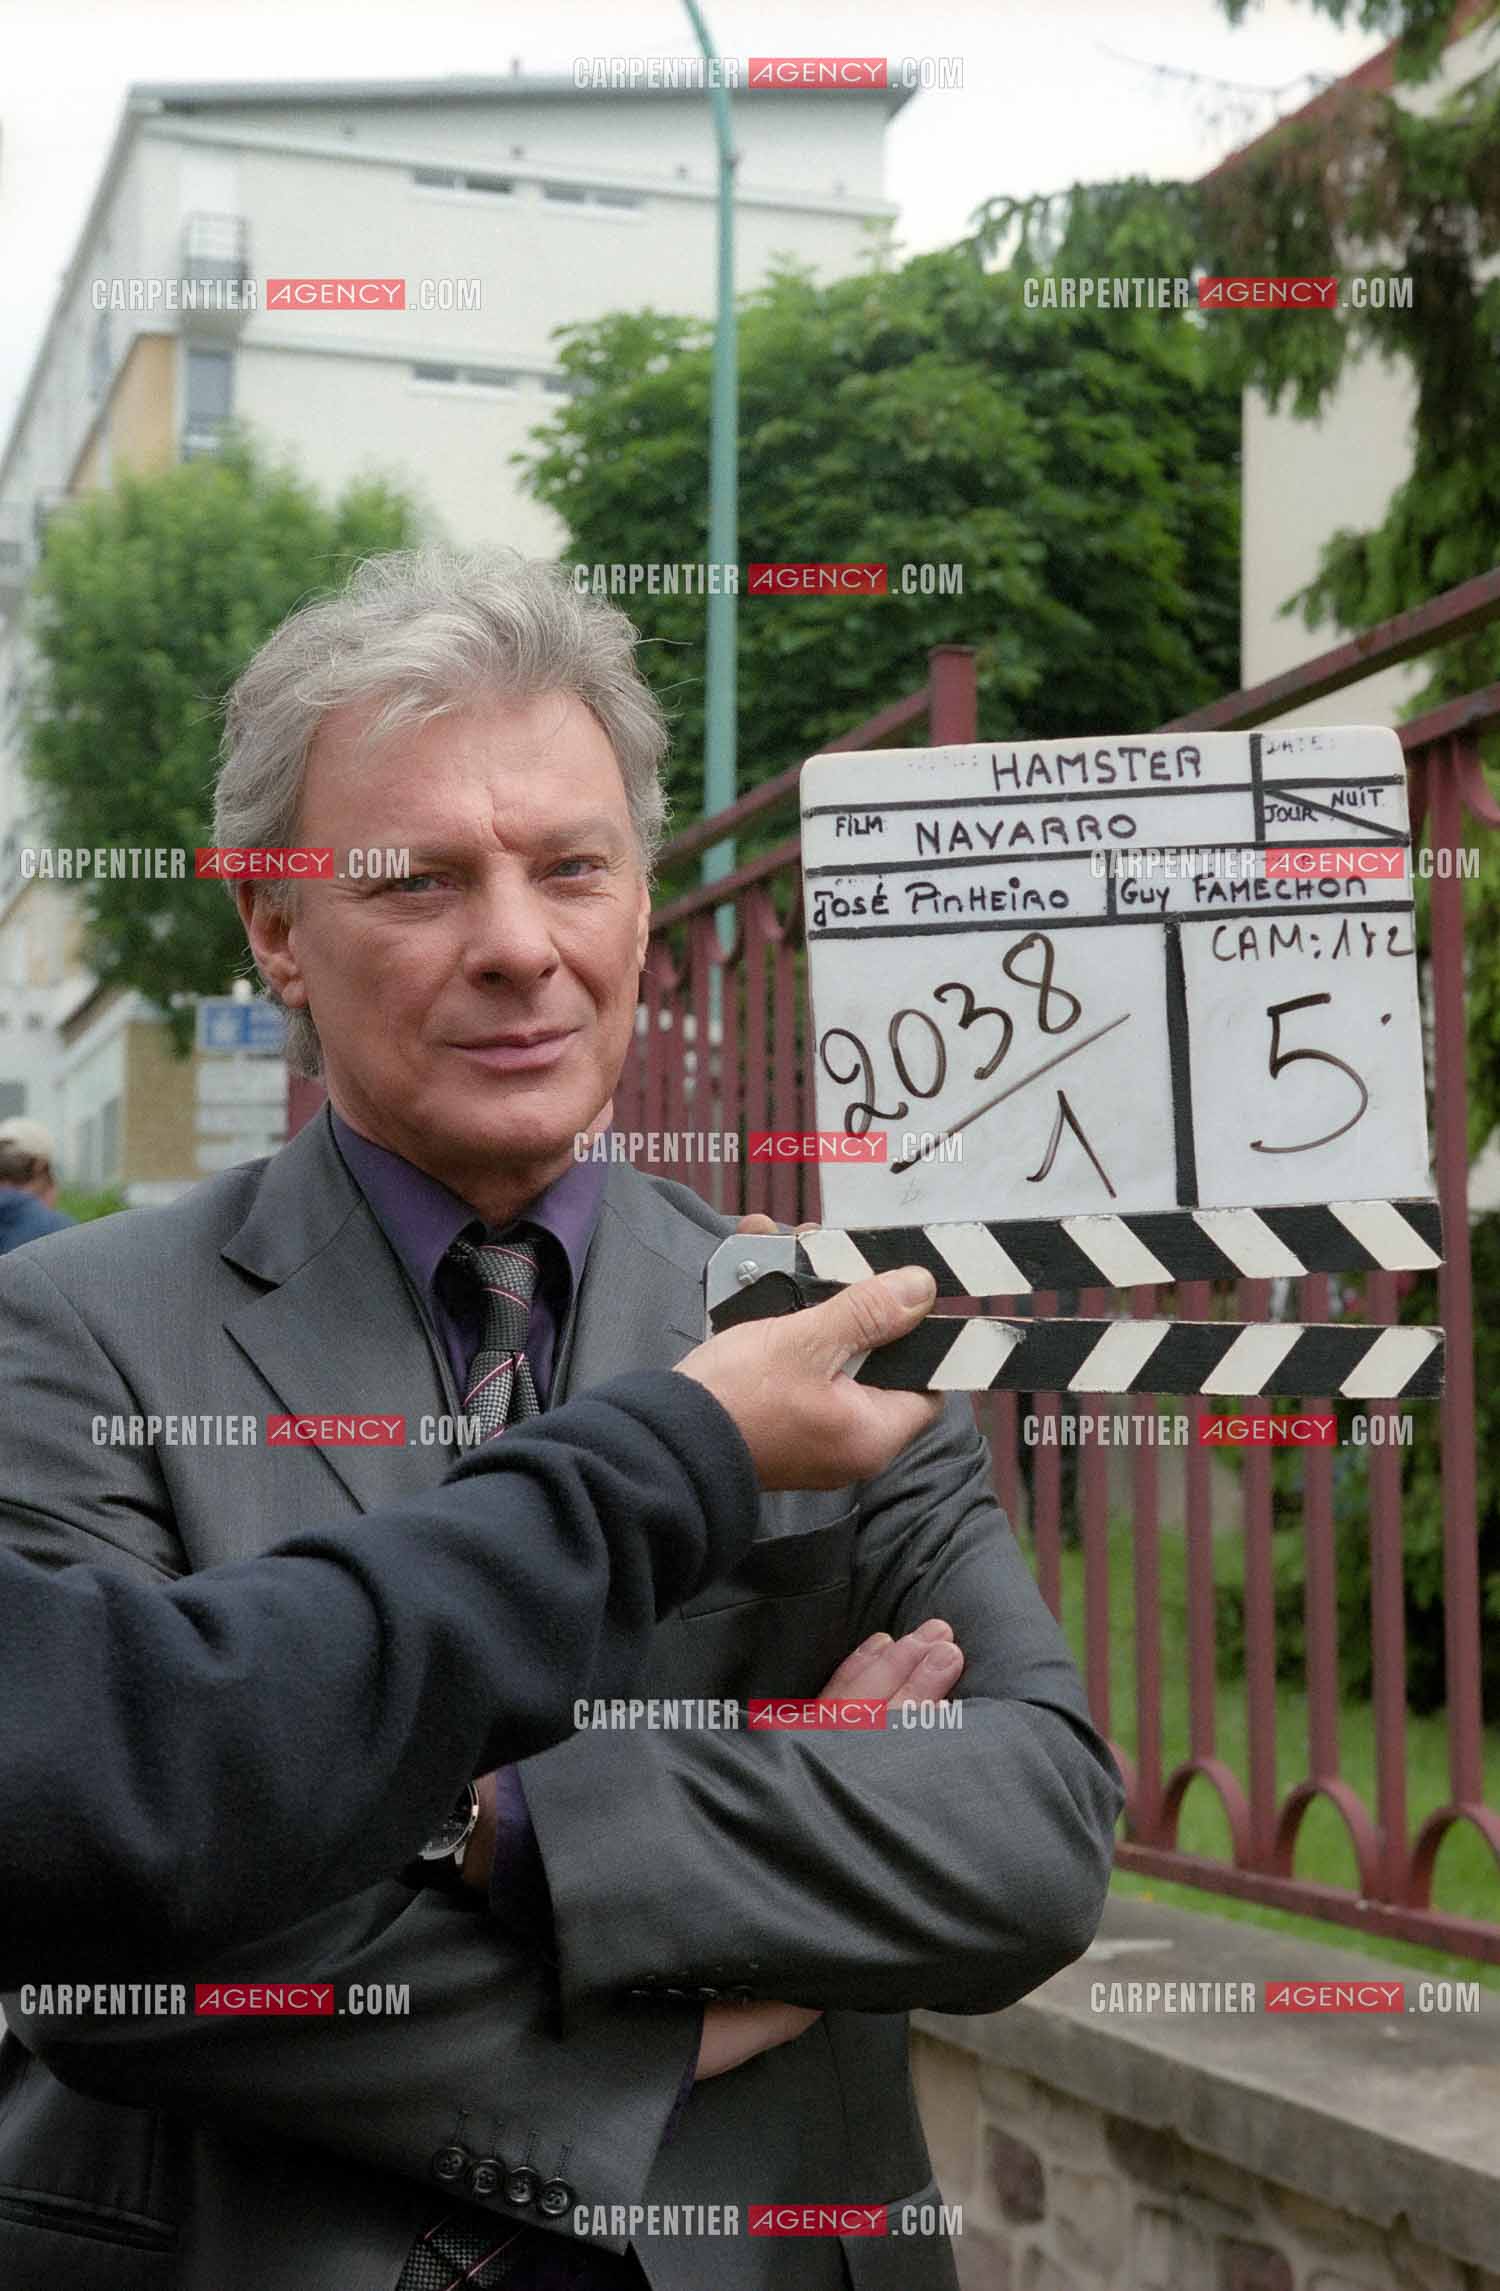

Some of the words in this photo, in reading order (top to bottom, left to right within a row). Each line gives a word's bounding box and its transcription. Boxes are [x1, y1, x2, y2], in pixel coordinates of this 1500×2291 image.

[992, 745, 1201, 792] HAMSTER
[915, 813, 1137, 856] NAVARRO
[1264, 803, 1319, 824] JOUR
[1249, 992, 1369, 1153] 5
